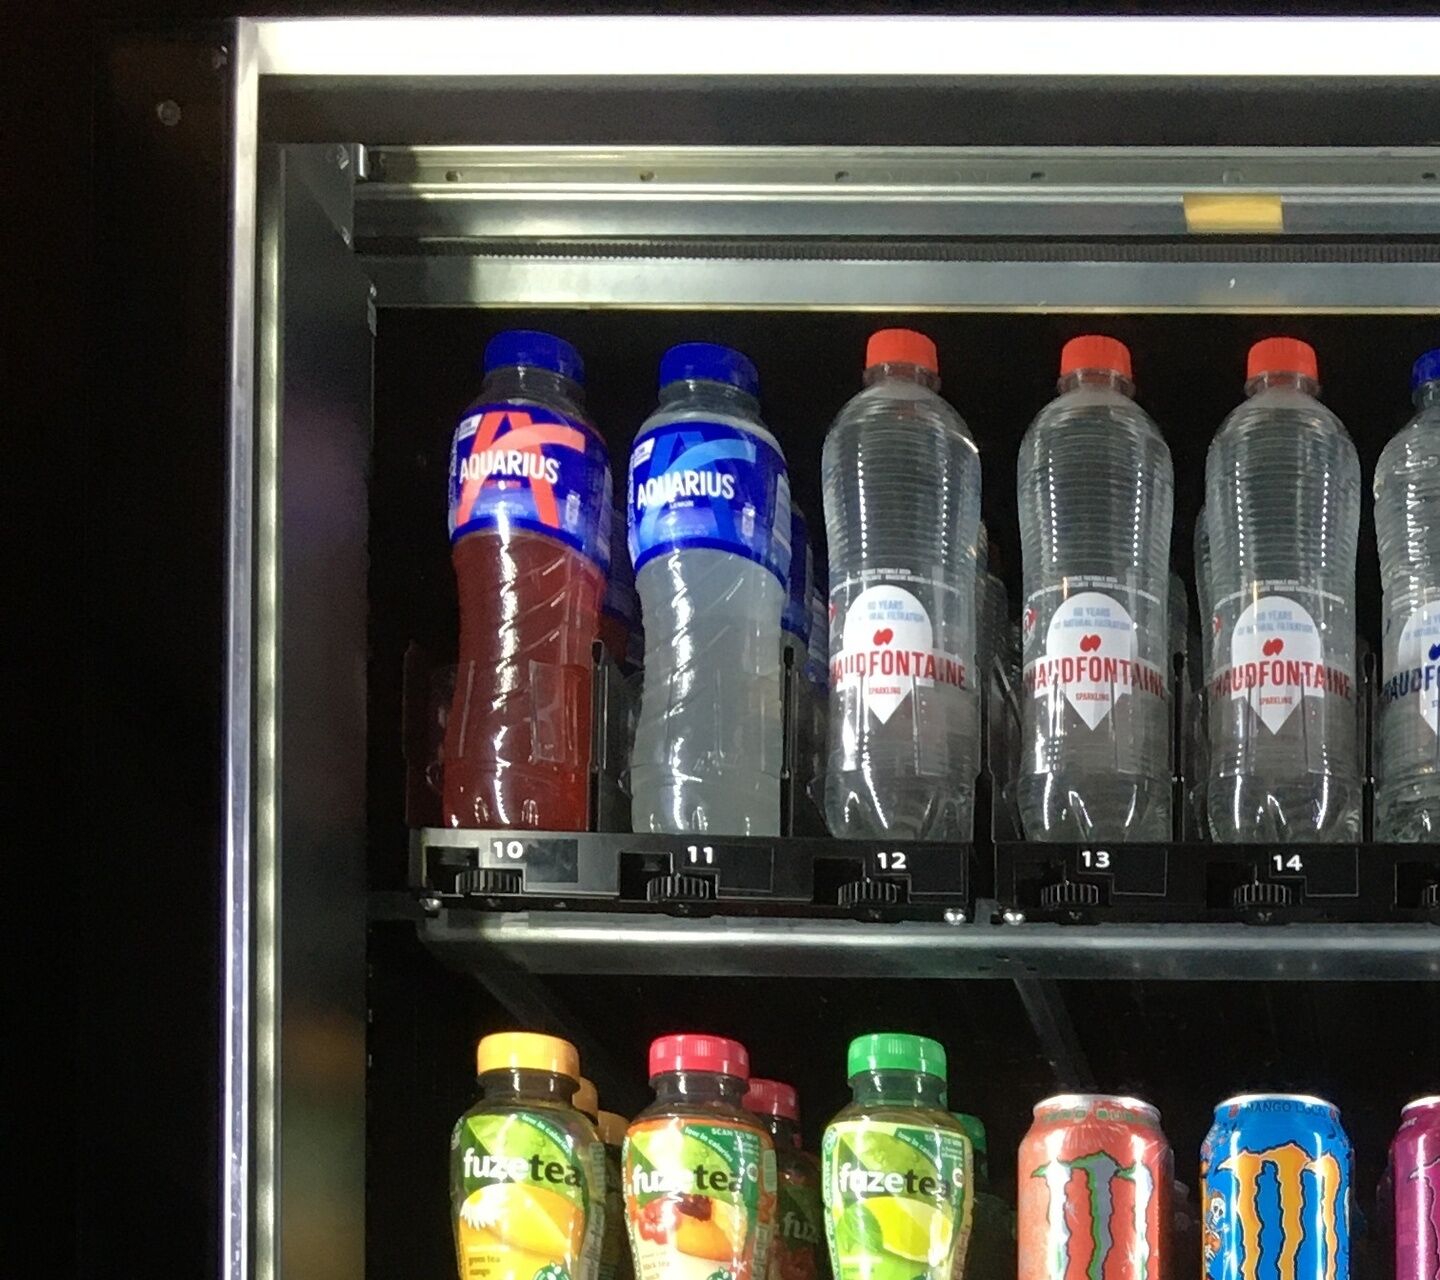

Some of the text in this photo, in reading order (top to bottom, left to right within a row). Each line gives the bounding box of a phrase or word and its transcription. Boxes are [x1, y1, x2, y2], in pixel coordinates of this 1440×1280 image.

[459, 450, 560, 484] AQUARIUS
[637, 470, 735, 508] AQUARIUS
[493, 841, 524, 859] 10
[687, 845, 713, 864] 11
[1081, 850, 1110, 868] 13
[877, 851, 907, 869] 12
[1273, 854, 1303, 871] 14
[463, 1147, 582, 1188] fuzetea
